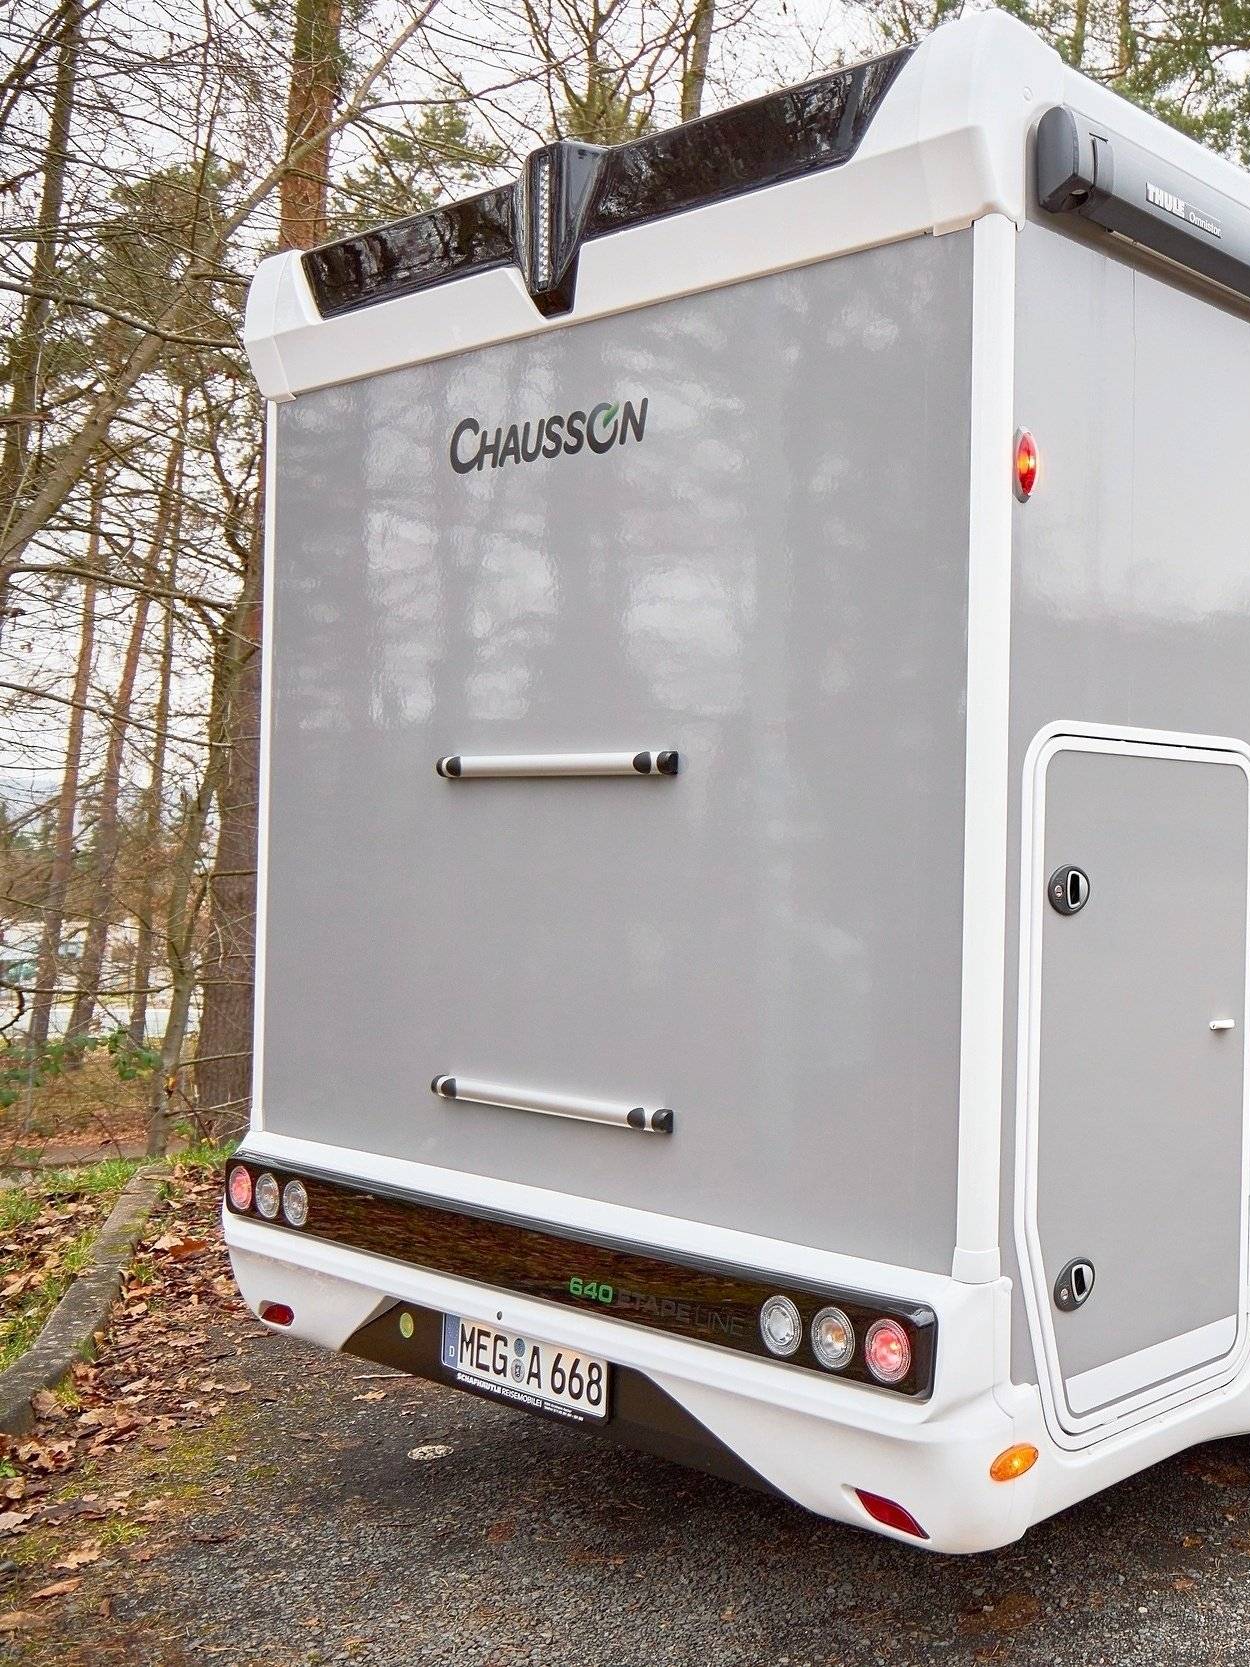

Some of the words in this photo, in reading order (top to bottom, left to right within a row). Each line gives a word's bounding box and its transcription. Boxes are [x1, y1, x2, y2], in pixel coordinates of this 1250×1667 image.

[1146, 182, 1185, 219] THULE
[1188, 211, 1222, 238] Omnistor
[449, 397, 649, 475] CHAUSSON
[569, 1277, 613, 1303] 640
[617, 1288, 692, 1323] ETAPE
[694, 1306, 745, 1335] LINE
[448, 1345, 455, 1357] D
[459, 1323, 509, 1378] MEG
[526, 1345, 542, 1390] A
[550, 1352, 603, 1406] 668
